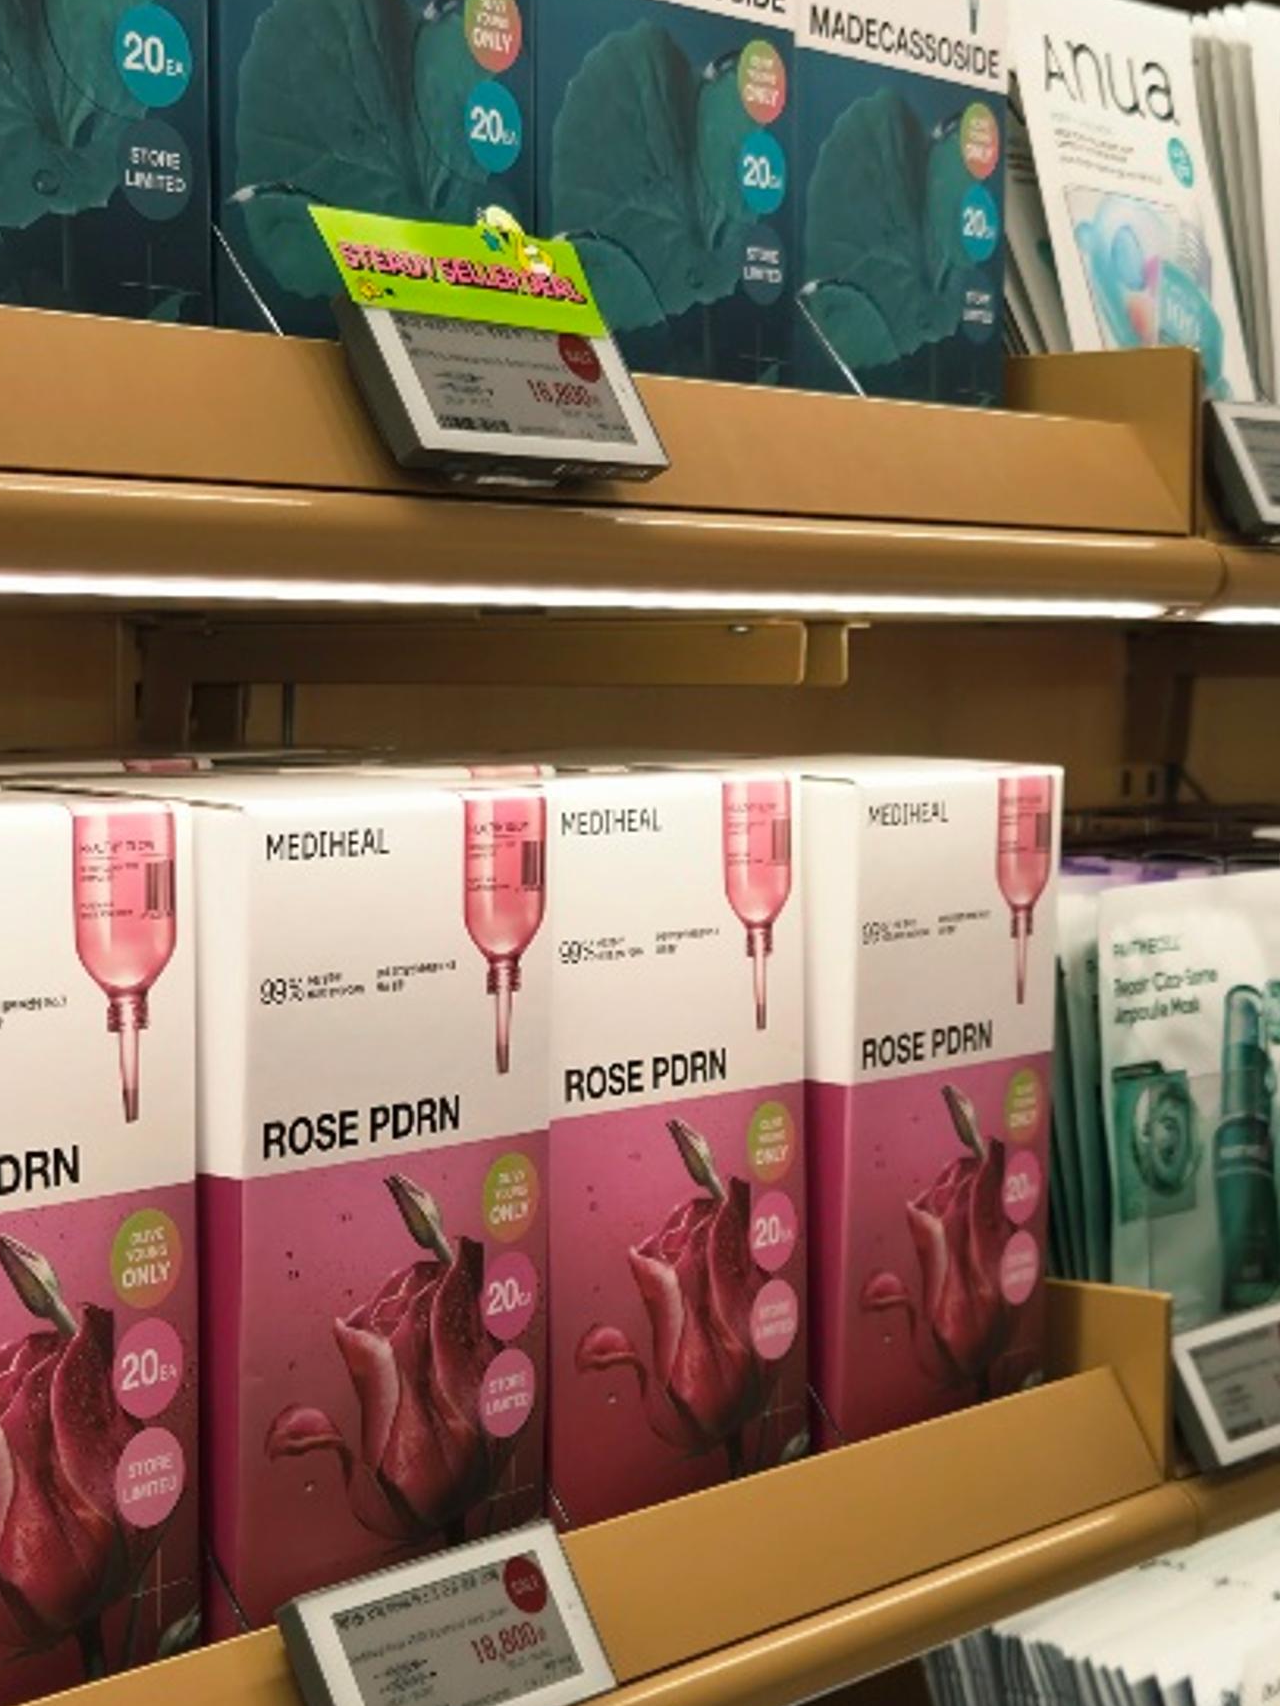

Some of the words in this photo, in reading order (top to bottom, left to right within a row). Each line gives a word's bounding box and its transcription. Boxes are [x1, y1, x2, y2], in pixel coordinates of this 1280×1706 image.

[808, 3, 1001, 81] MADECASSOSIDE
[1041, 32, 1181, 130] Anua
[129, 144, 182, 172] STORE
[124, 166, 188, 198] LIMITED
[339, 240, 435, 284] STEADY
[560, 807, 663, 838] MEDIHEAL
[867, 800, 950, 829] MEDIHEAL
[265, 828, 390, 861] MEDIHEAL
[861, 1026, 927, 1071] ROSE
[932, 1019, 994, 1059] PDRN
[564, 1057, 646, 1104] ROSE
[651, 1047, 728, 1090] PDRN
[262, 1110, 360, 1161] ROSE
[370, 1095, 461, 1144] PDRN
[120, 1259, 173, 1290] ONLY
